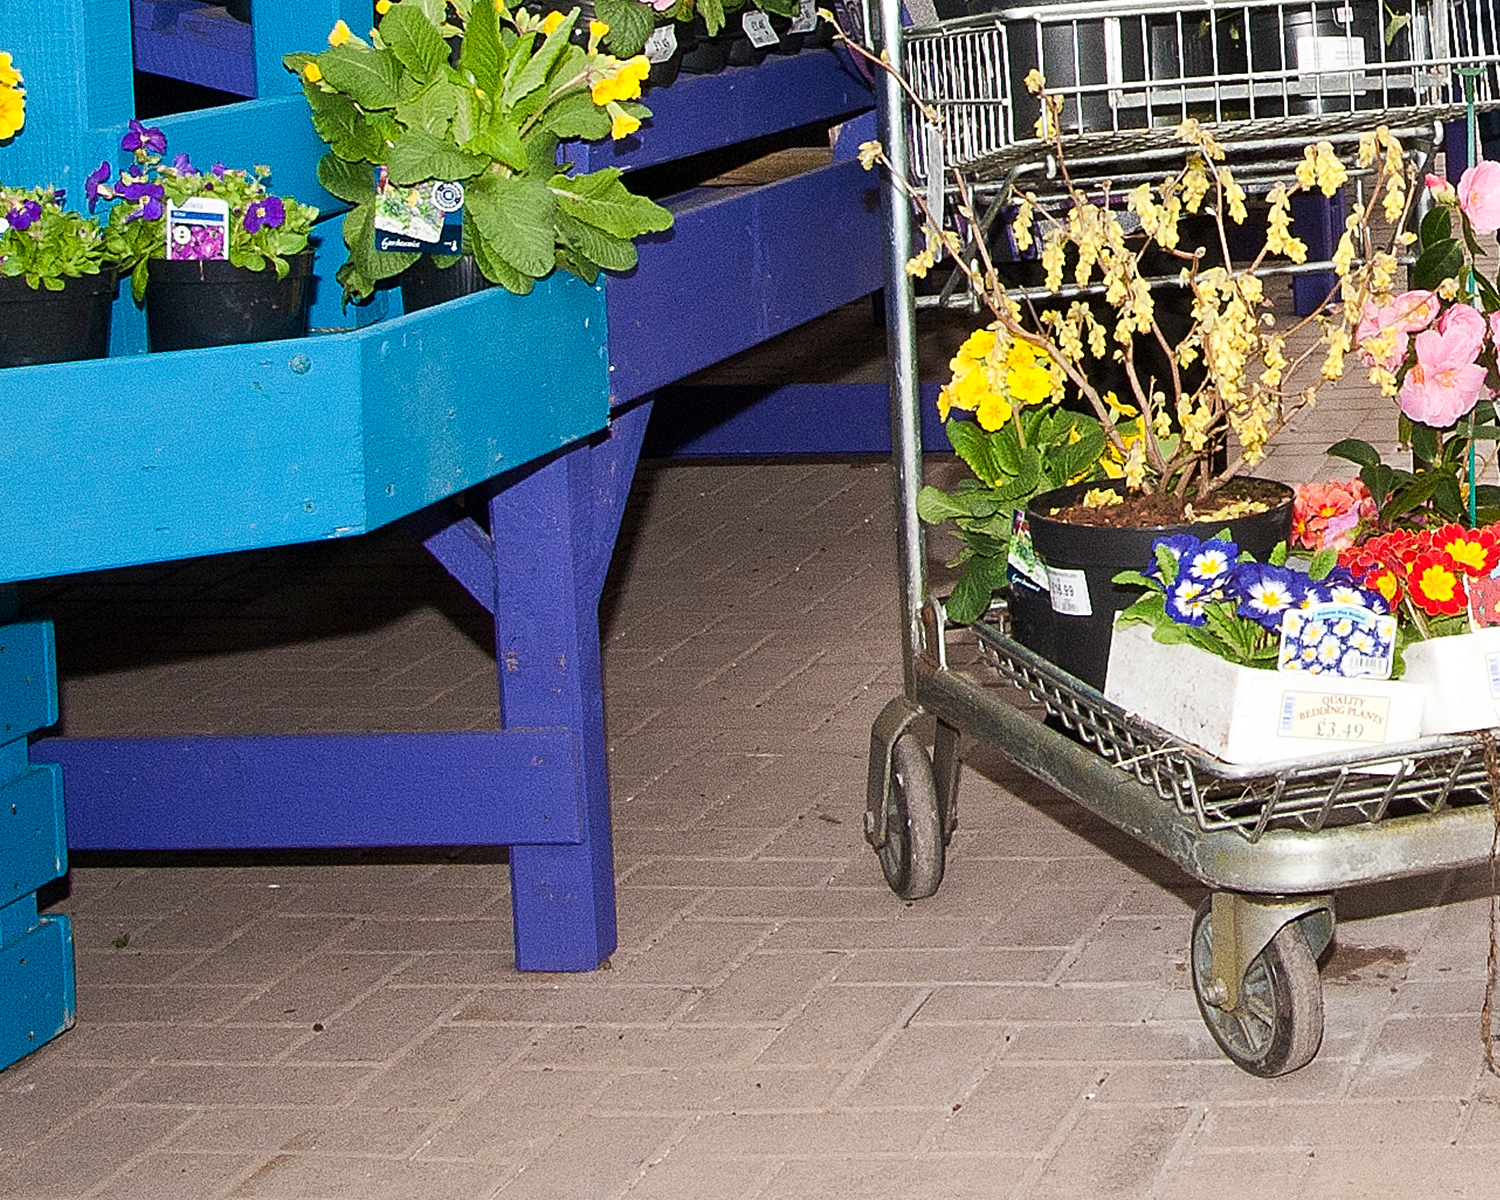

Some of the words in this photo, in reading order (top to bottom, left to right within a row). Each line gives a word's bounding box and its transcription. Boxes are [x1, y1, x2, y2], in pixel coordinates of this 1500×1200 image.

[1322, 696, 1366, 707] QUALITY
[1299, 704, 1345, 720] BEDDING
[1347, 706, 1383, 725] PLANTS
[1316, 722, 1364, 739] £3.49
